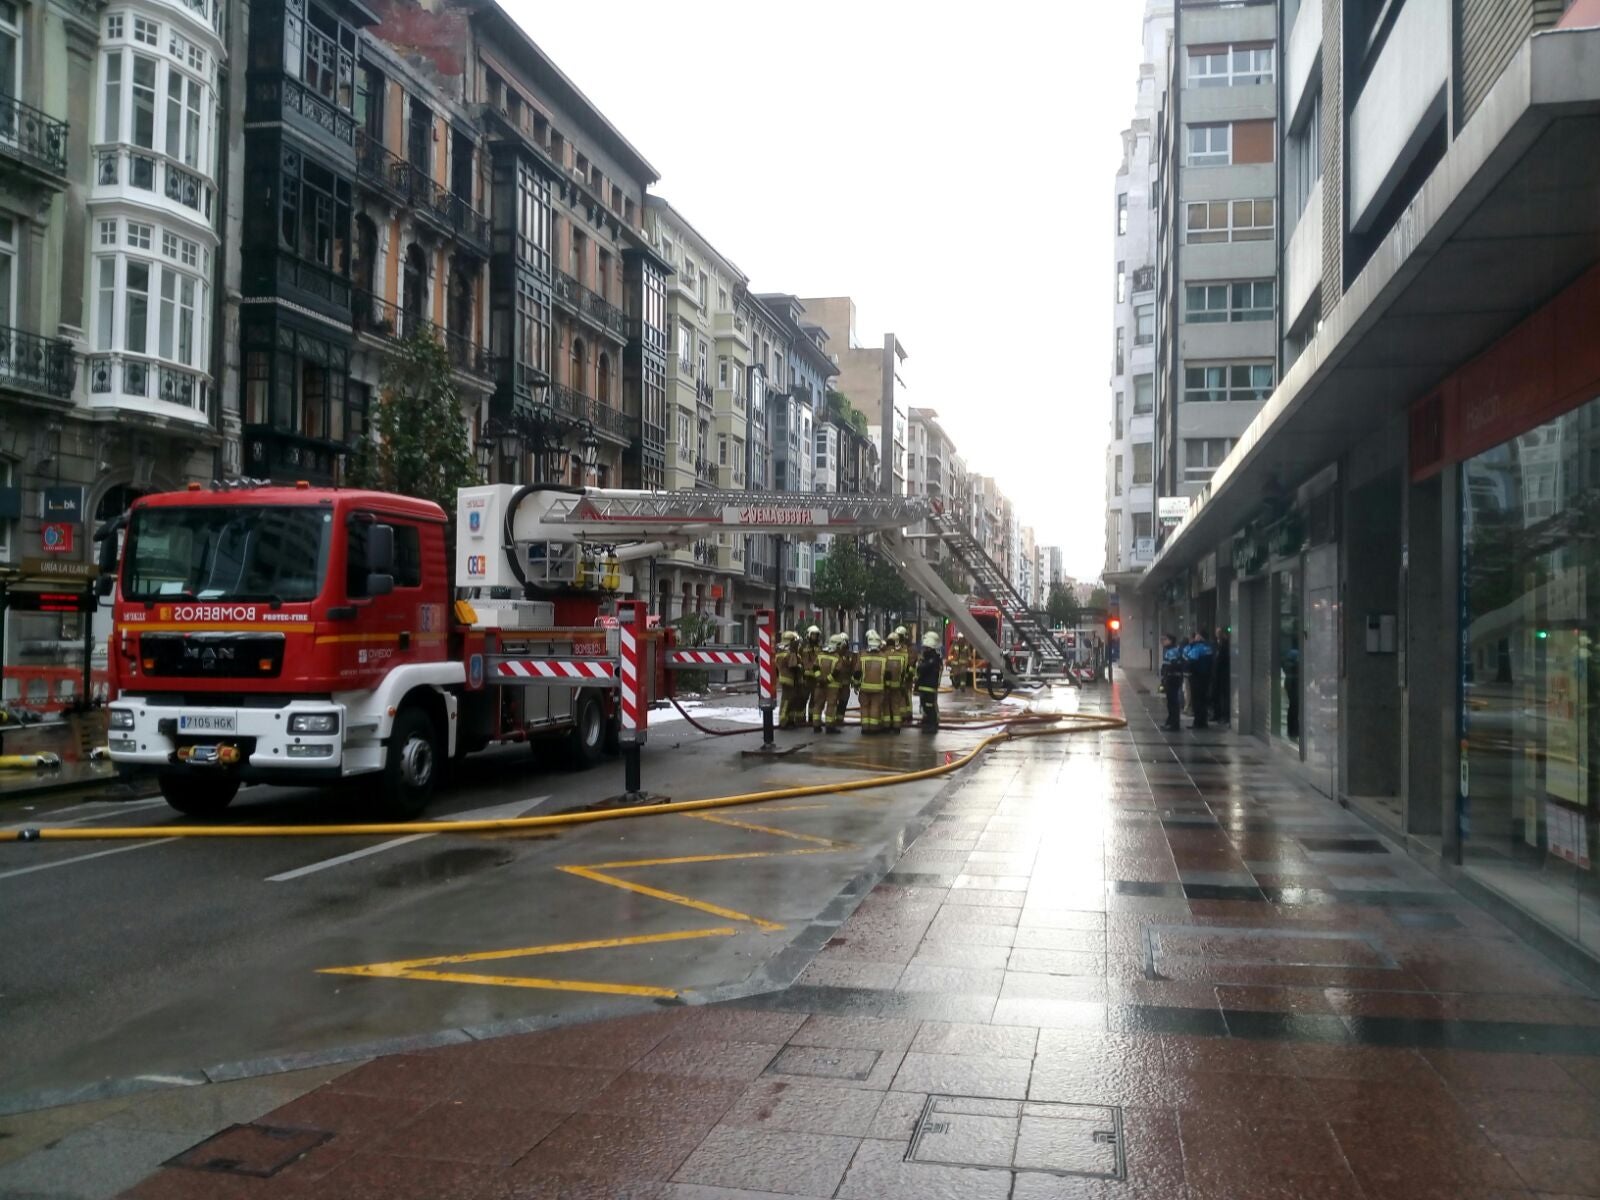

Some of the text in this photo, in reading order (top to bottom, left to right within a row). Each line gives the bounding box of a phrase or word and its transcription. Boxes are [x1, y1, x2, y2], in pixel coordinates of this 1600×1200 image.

[262, 613, 308, 621] PROTEC-FIRE
[184, 647, 235, 660] MAN
[187, 716, 233, 729] 7105 HGK
